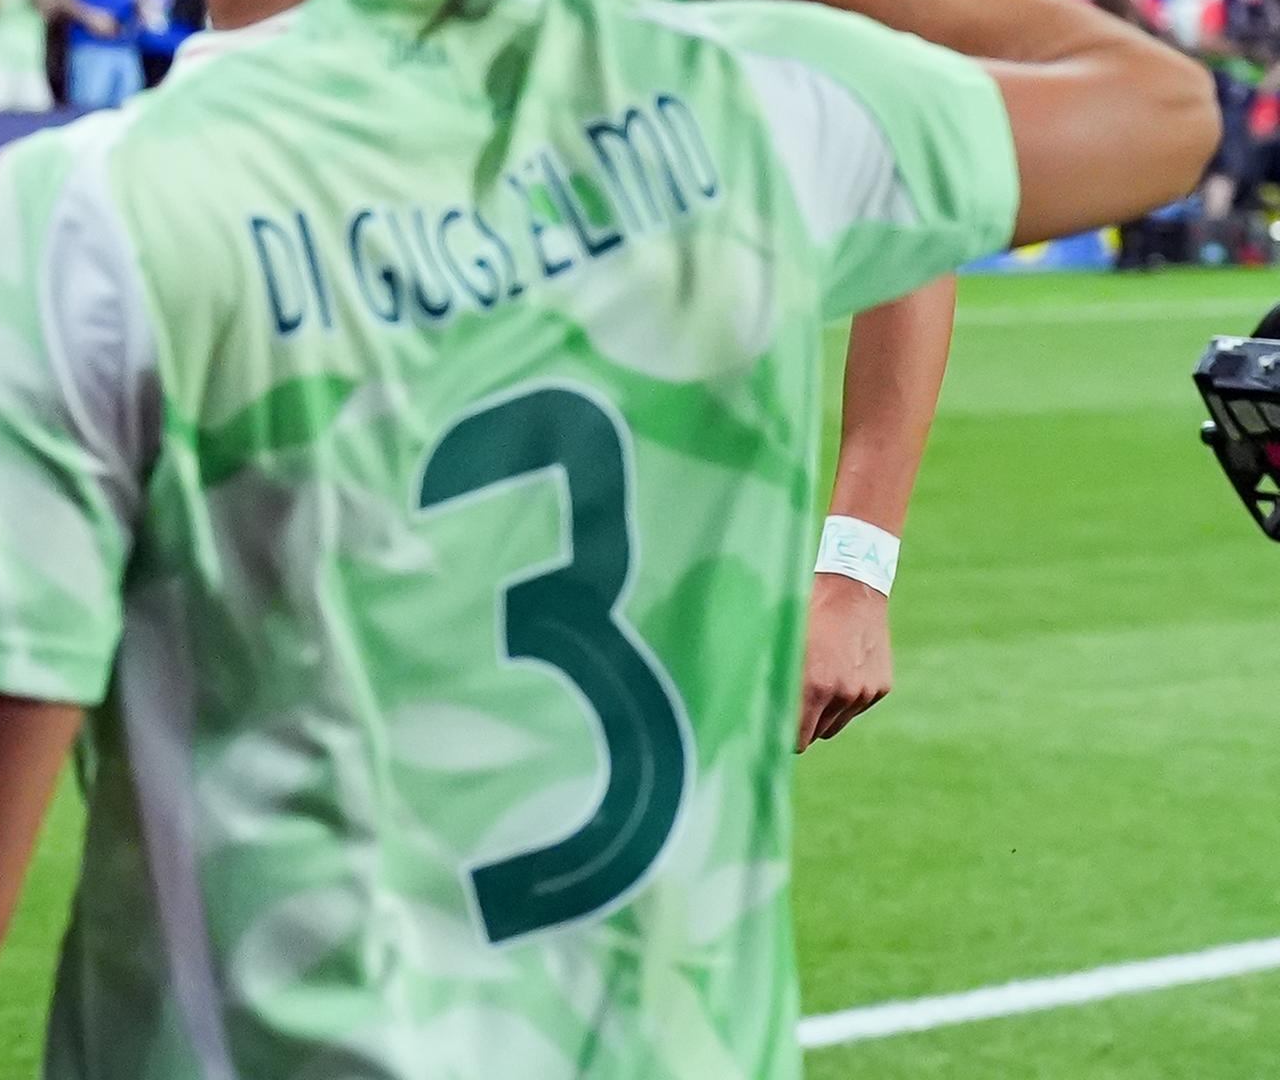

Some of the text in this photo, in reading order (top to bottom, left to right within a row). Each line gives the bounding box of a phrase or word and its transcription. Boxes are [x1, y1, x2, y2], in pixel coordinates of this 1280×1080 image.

[251, 92, 720, 334] DI GUGLELMO
[418, 384, 688, 944] 3
